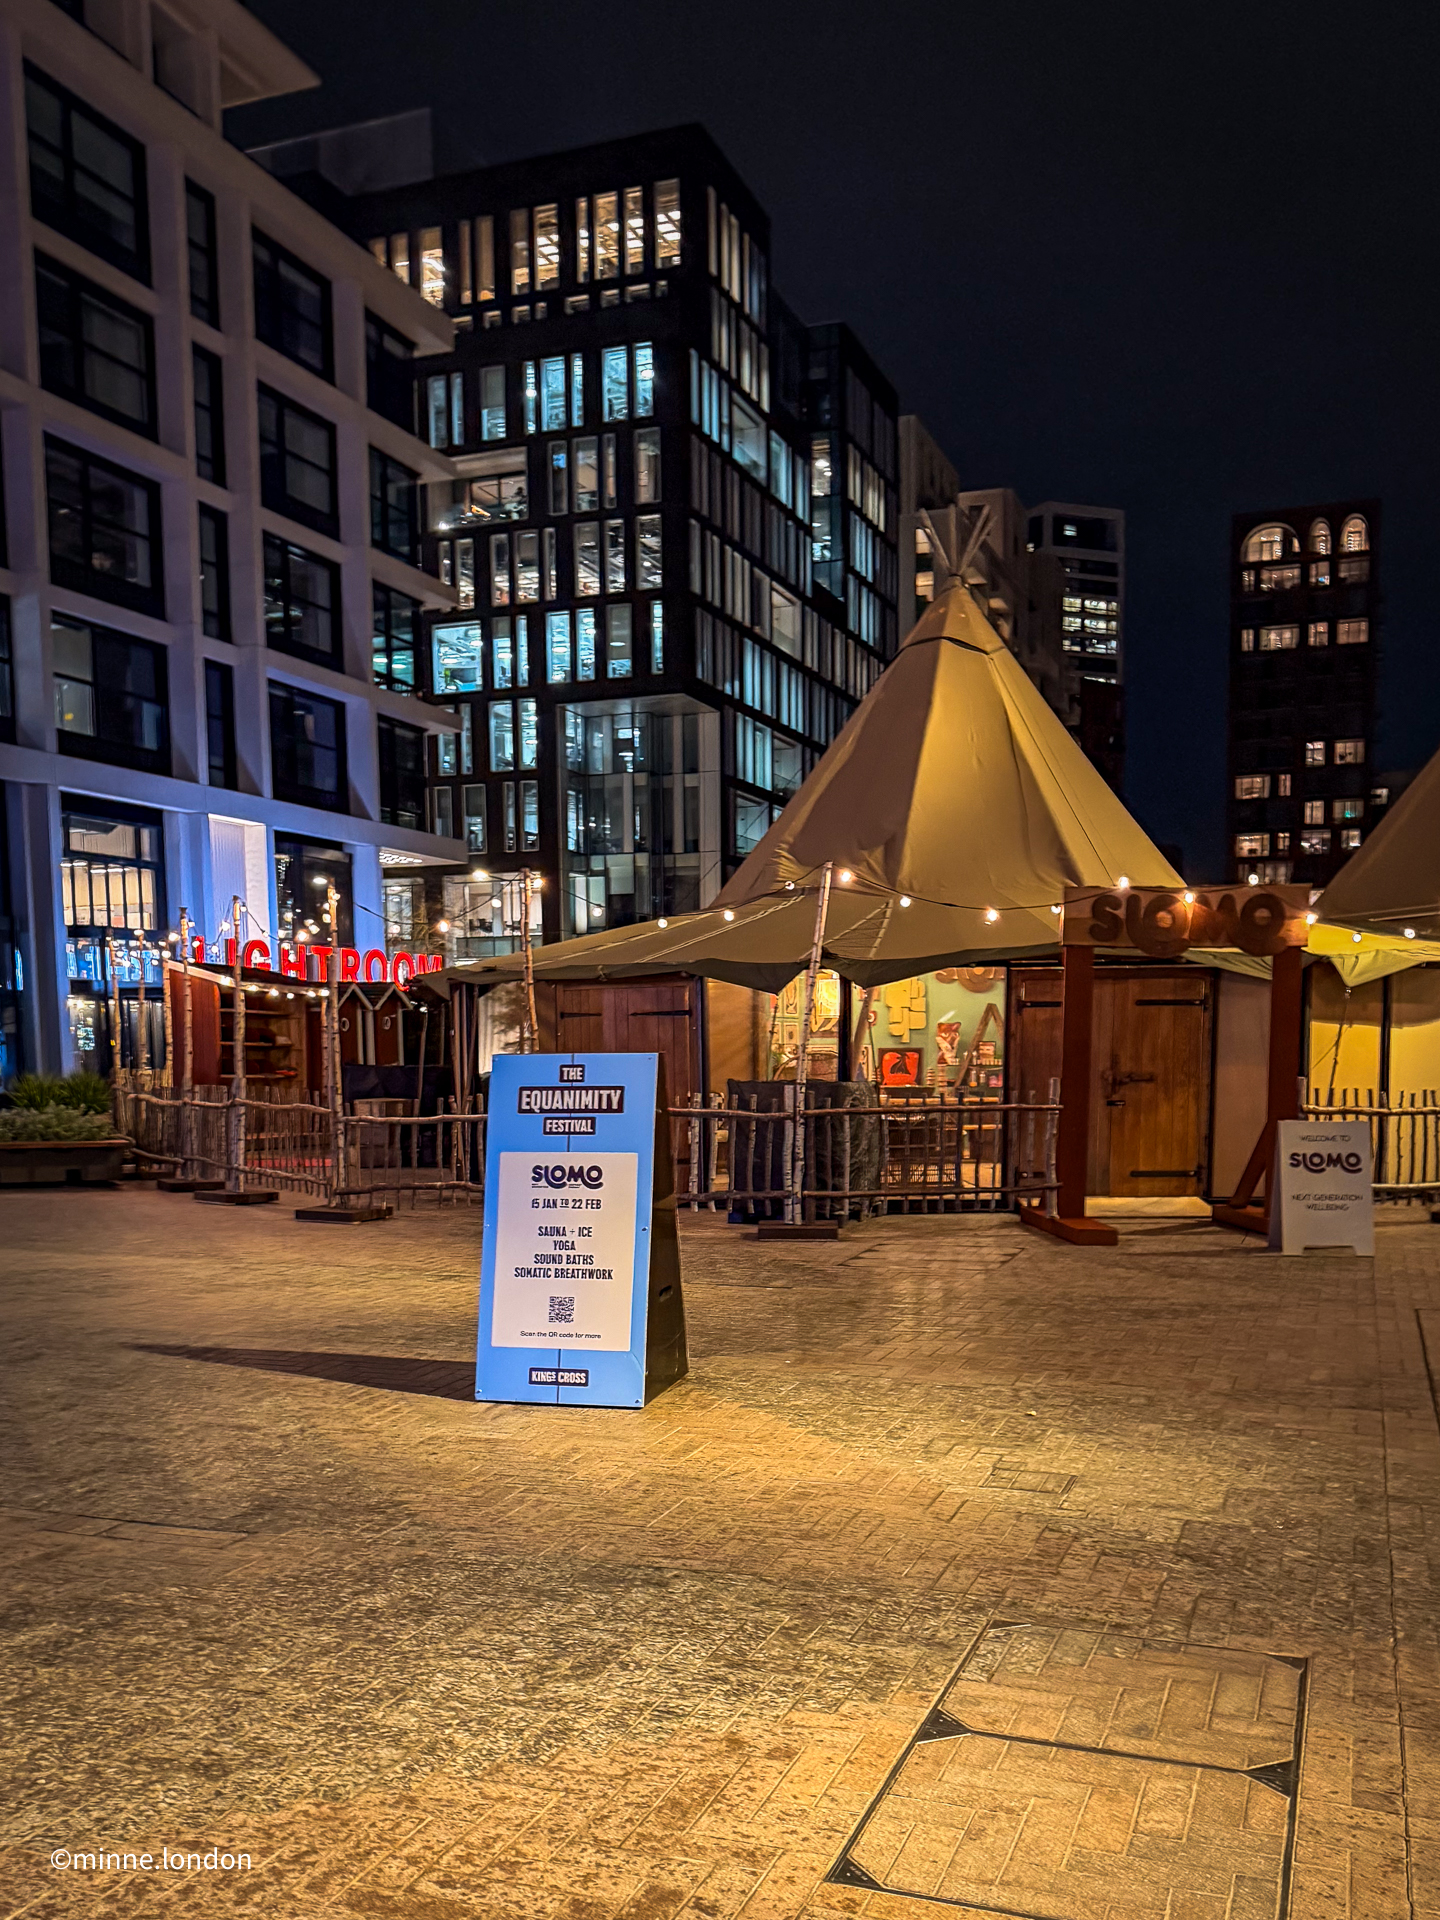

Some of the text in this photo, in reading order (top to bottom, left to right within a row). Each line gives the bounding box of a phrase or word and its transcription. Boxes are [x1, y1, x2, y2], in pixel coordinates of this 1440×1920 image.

[1089, 893, 1288, 958] SLOMO
[561, 1067, 583, 1080] THE
[521, 1089, 622, 1113] EQUANIMITY
[545, 1119, 594, 1132] FESTIVAL
[1340, 1134, 1352, 1142] TO
[1289, 1152, 1363, 1174] SLOMO
[531, 1164, 604, 1189] SLOMO
[531, 1198, 602, 1210] 15 JAN TO 22 FEB
[537, 1225, 567, 1237] SAUNA
[578, 1226, 593, 1238] ICE
[553, 1239, 576, 1251] YOGA
[533, 1253, 594, 1265] SOUND BATHS
[514, 1267, 614, 1280] SOMATIC BREATHWORK
[557, 1371, 586, 1384] CROSS
